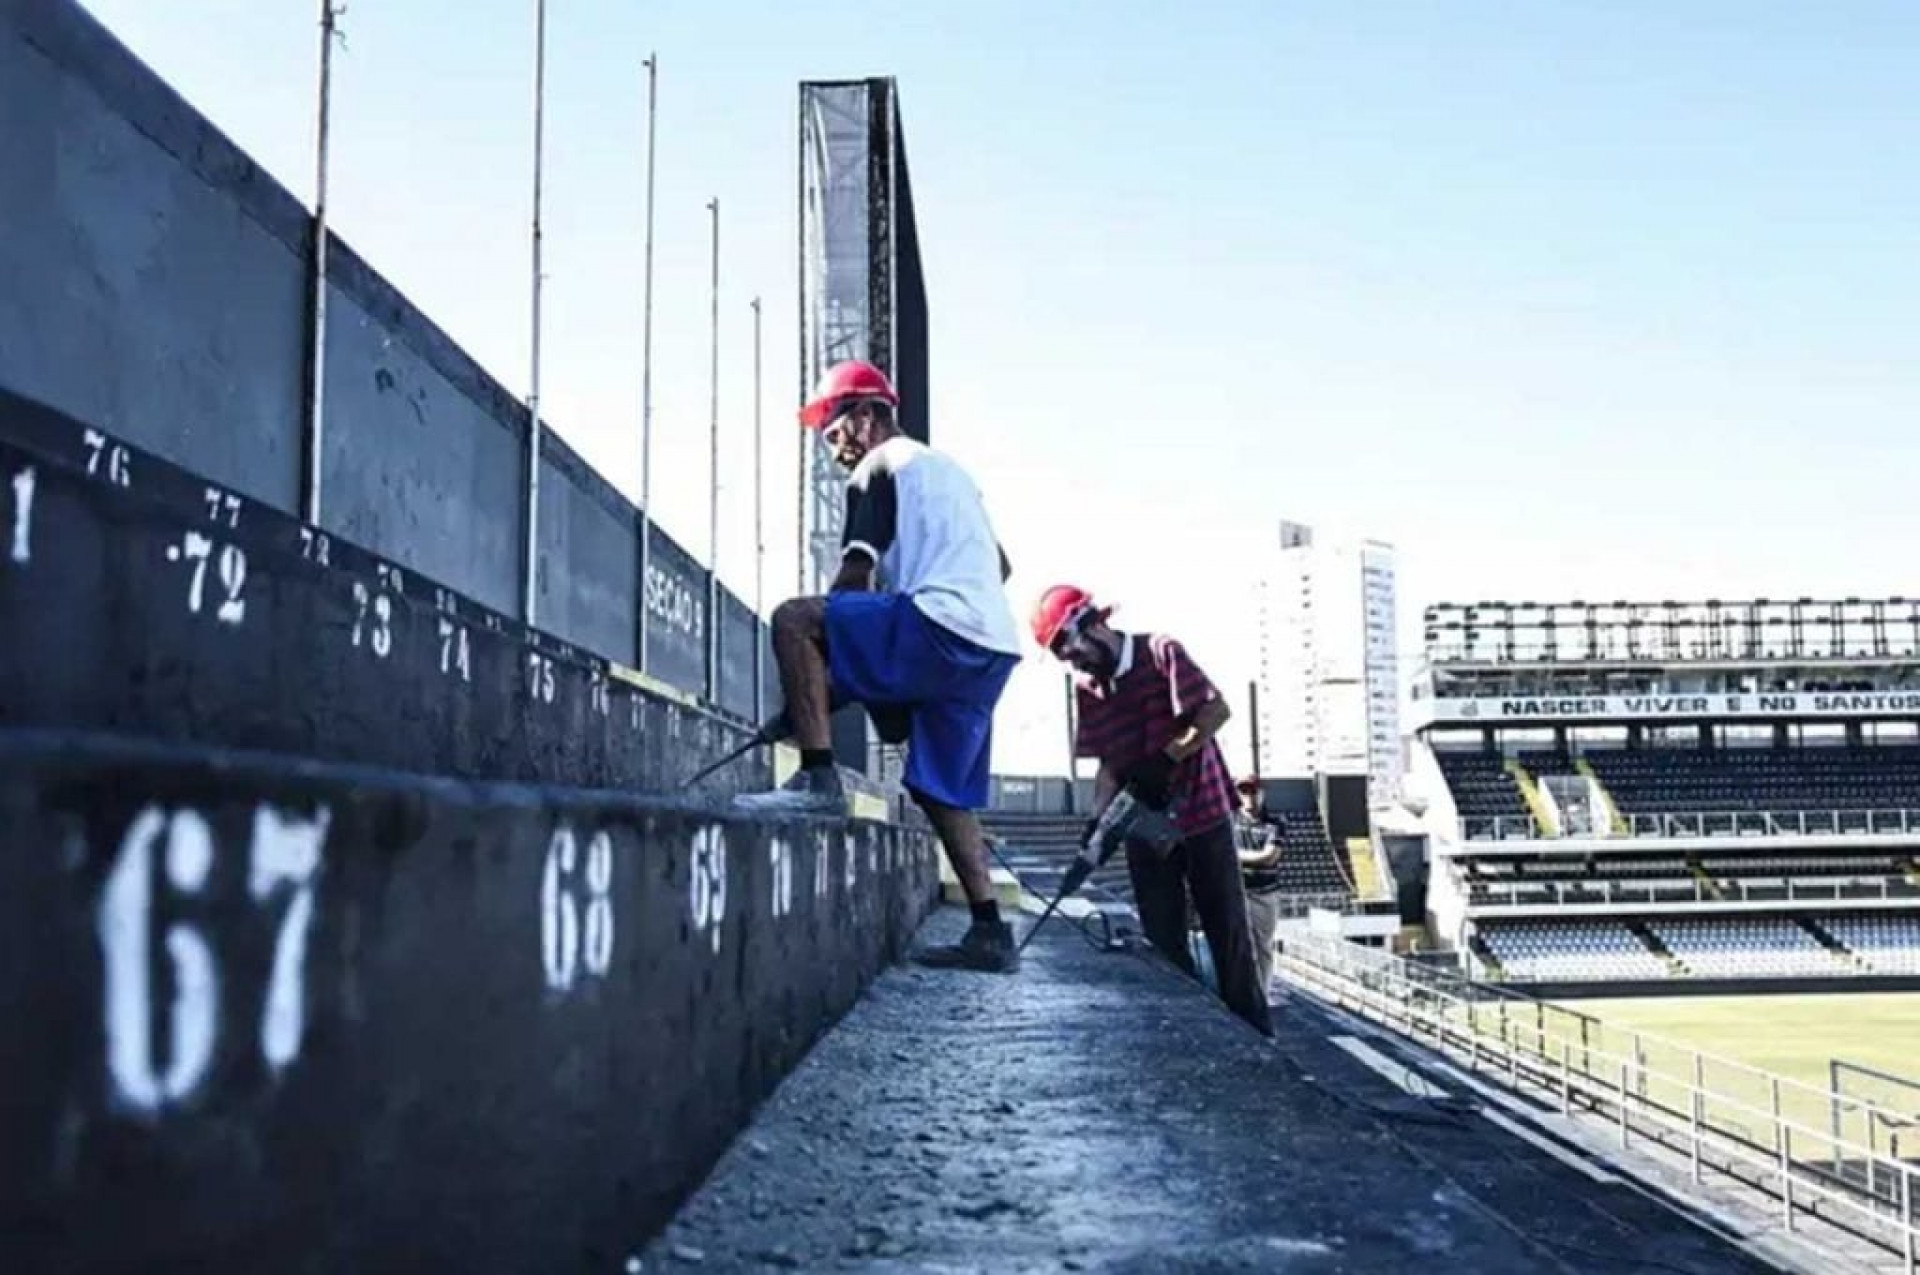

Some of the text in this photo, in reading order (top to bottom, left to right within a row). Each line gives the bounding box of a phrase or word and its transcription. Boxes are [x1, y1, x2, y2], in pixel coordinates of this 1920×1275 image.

[84, 428, 130, 487] 76
[205, 487, 242, 527] 77
[184, 531, 247, 624] 72
[352, 583, 392, 657] 73
[438, 617, 470, 682] 74
[529, 653, 556, 703] 75
[1624, 697, 1709, 713] VIVER
[1726, 697, 1742, 712] E
[1759, 696, 1796, 711] NO
[1814, 695, 1920, 711] SANTOS
[542, 827, 614, 990] 68
[690, 824, 727, 932] 69
[101, 805, 331, 1112] 67
